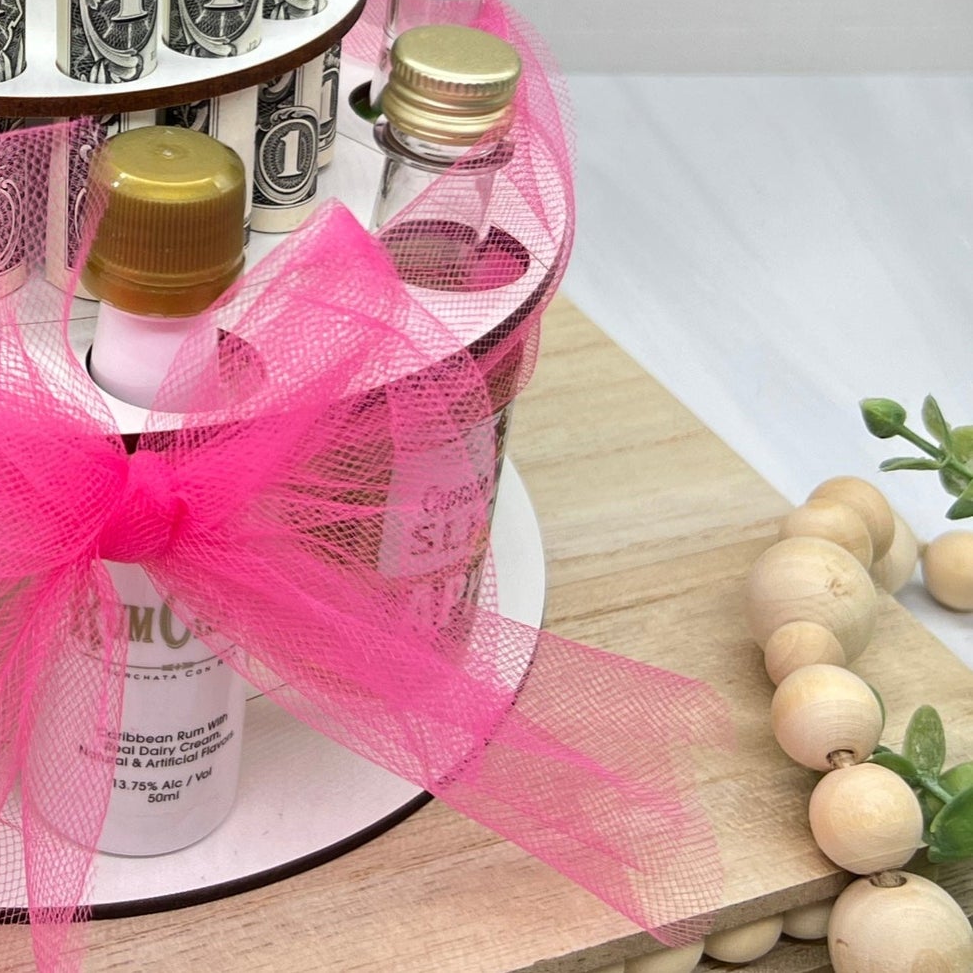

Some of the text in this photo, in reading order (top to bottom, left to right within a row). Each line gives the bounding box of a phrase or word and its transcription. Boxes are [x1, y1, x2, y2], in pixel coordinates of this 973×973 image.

[277, 130, 302, 177] 1
[177, 726, 204, 741] Rum
[208, 712, 228, 731] With
[132, 758, 142, 768] &
[145, 751, 198, 768] Artificial
[139, 745, 176, 756] Dairy
[113, 778, 158, 791] 13.75%
[162, 778, 183, 790] Alc
[195, 766, 212, 782] Vol
[147, 791, 180, 803] 50ml
